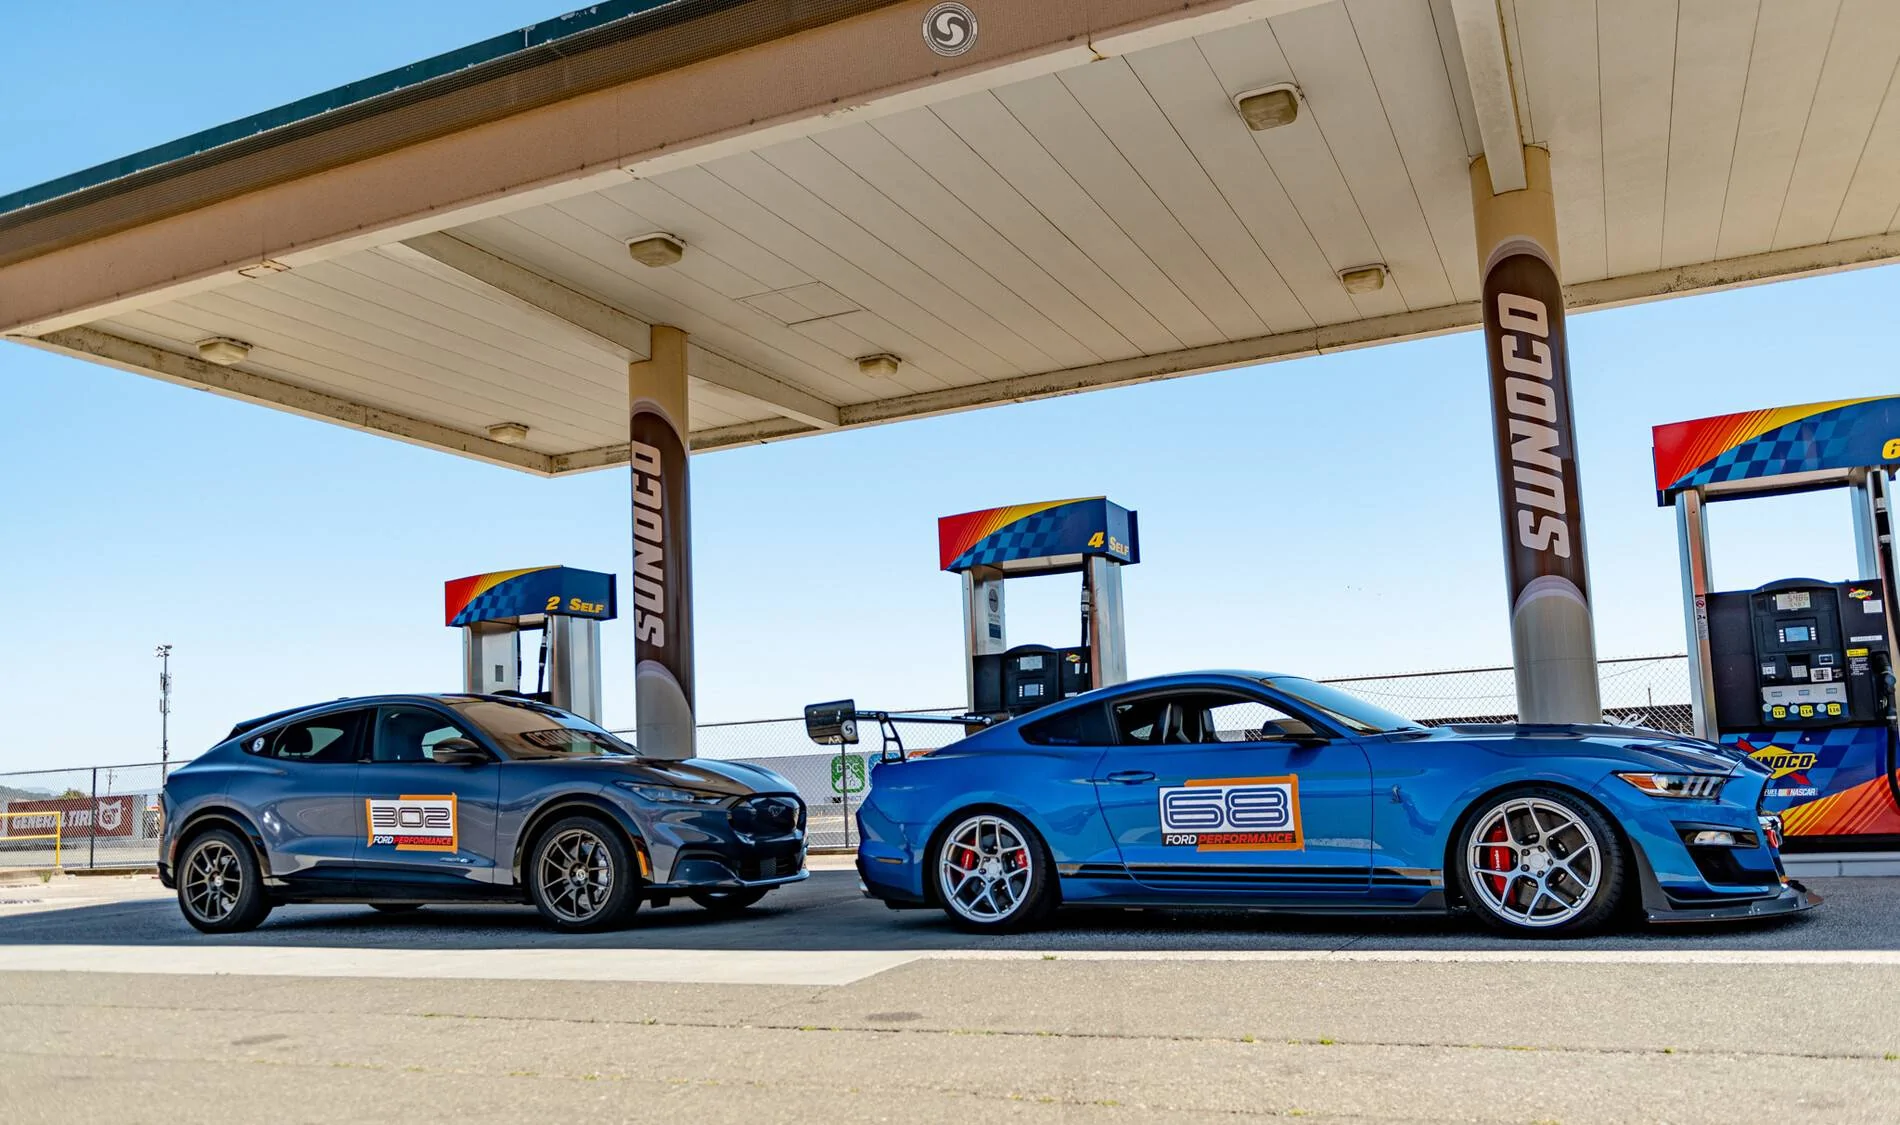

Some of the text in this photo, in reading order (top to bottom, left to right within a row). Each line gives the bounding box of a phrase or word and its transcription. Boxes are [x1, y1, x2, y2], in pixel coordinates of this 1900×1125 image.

[1497, 293, 1571, 559] SUNOCO
[631, 440, 665, 648] SUNOCO
[1088, 531, 1104, 548] 4
[545, 595, 560, 610] 2
[372, 807, 451, 828] 302
[1163, 787, 1289, 829] 68
[373, 836, 452, 845] FORD PERFORMANCE
[1166, 833, 1293, 845] FORD PERFORMANCE
